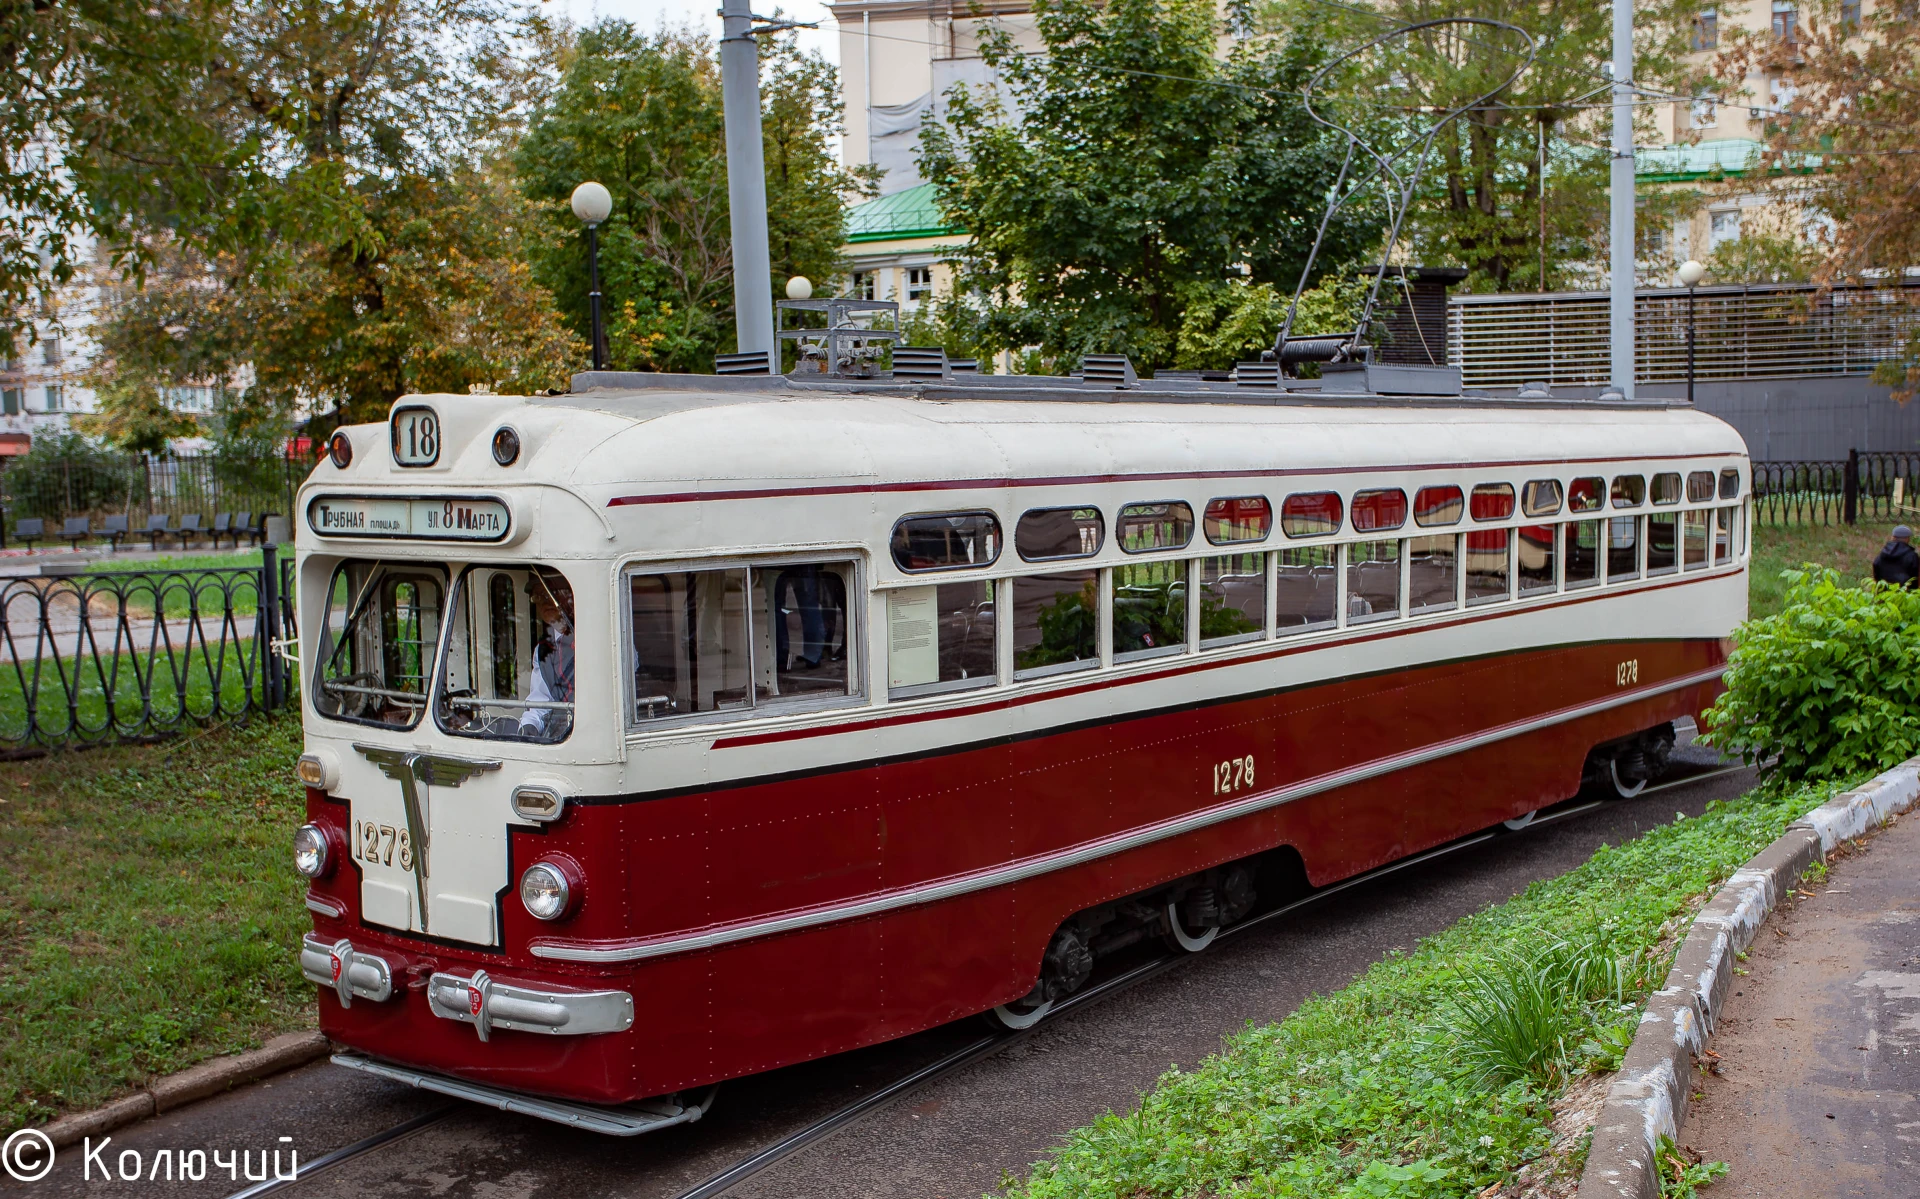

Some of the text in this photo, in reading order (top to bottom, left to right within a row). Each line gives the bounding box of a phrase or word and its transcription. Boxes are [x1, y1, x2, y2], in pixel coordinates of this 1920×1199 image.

[409, 416, 436, 458] 18
[442, 500, 454, 529] 8
[1616, 658, 1638, 687] 1278
[1213, 754, 1255, 796] 1278
[354, 819, 414, 872] 1278
